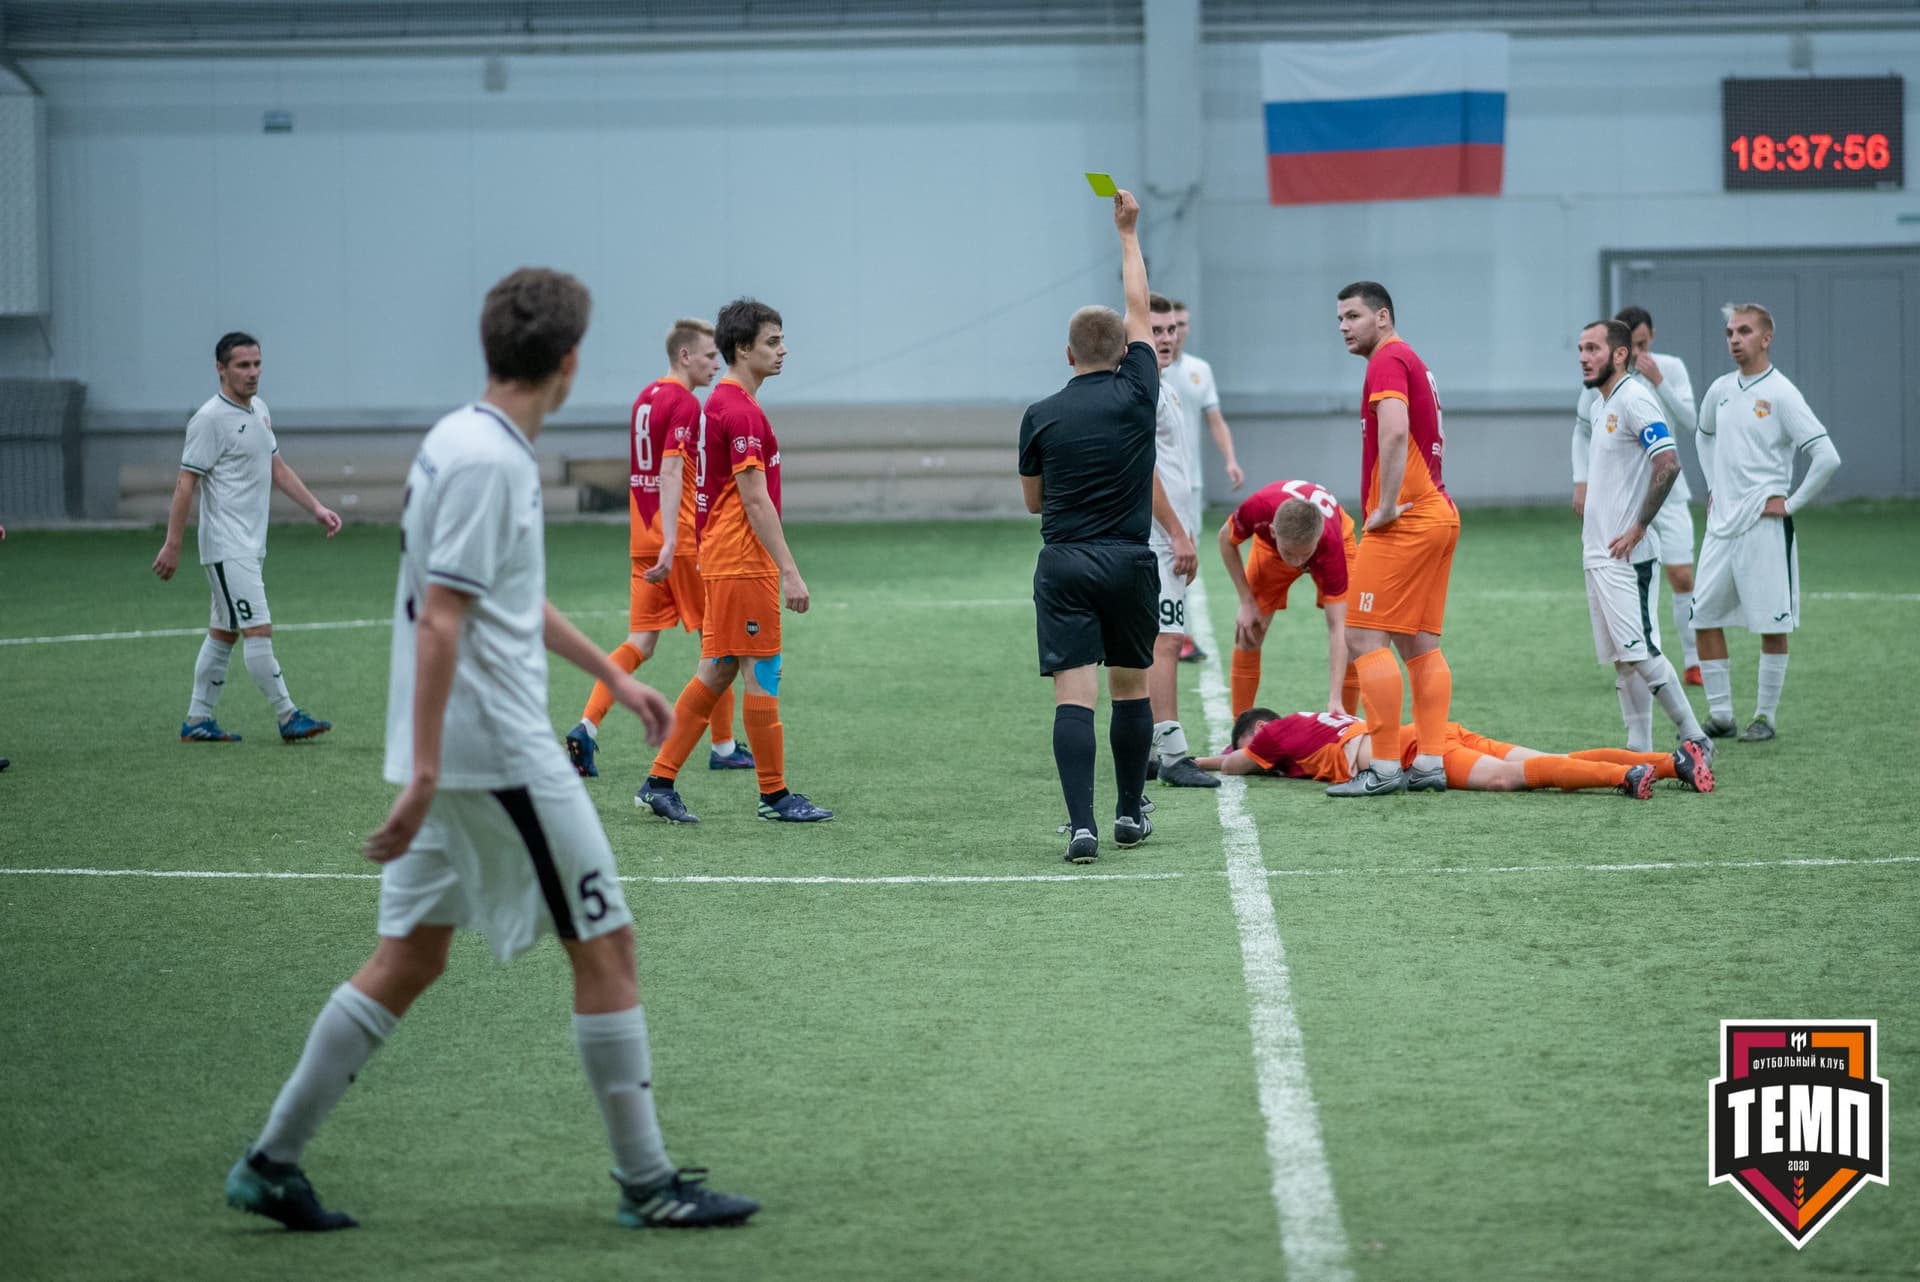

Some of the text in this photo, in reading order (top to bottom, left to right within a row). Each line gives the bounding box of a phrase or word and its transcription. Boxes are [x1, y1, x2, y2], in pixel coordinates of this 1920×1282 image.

[1731, 133, 1890, 171] 18:37:56
[635, 404, 652, 470] 8
[1644, 427, 1657, 443] C
[236, 599, 252, 621] 9
[1160, 599, 1184, 626] 98
[1359, 592, 1374, 612] 13
[580, 871, 607, 921] 5
